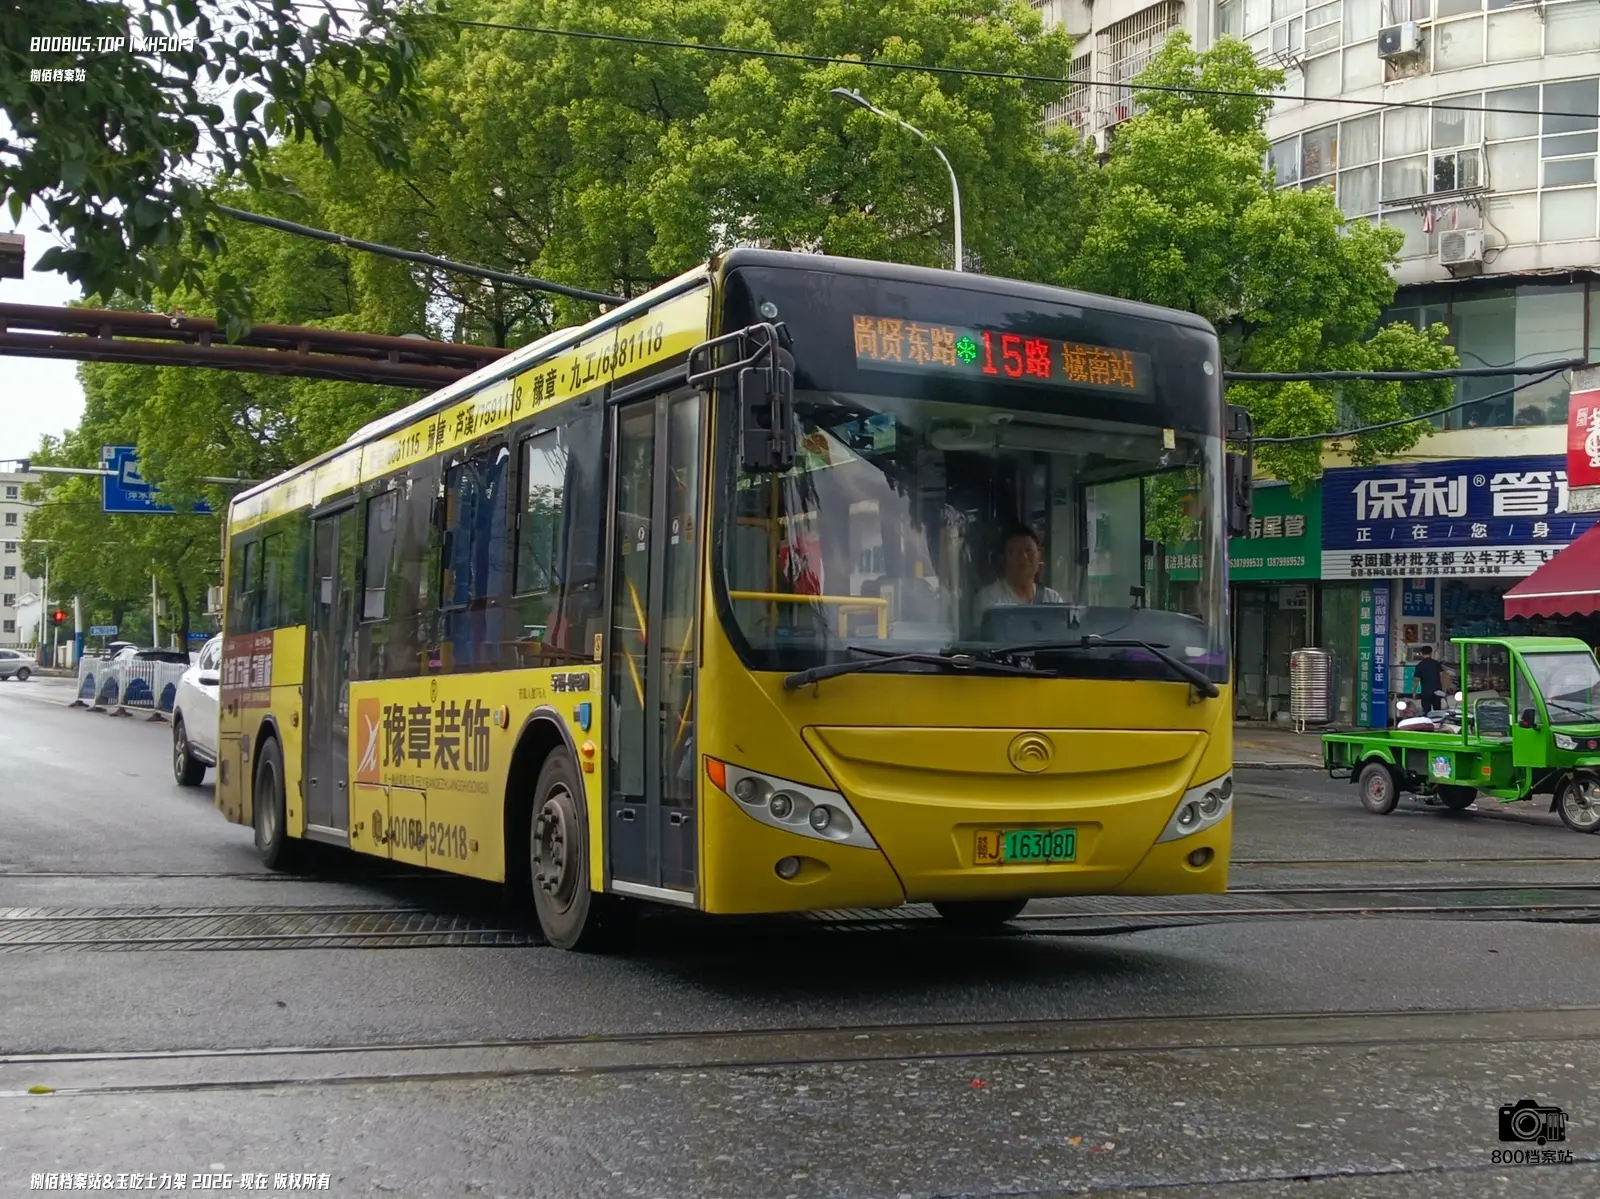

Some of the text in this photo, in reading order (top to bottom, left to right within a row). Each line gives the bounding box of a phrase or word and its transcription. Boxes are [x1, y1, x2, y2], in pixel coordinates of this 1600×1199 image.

[852, 315, 957, 367] 尚贤东路
[979, 330, 1052, 378] 15路
[1350, 552, 1455, 567] 安固建材批发部
[1462, 550, 1526, 565] 公牛开关
[382, 698, 491, 773] 豫章装饰
